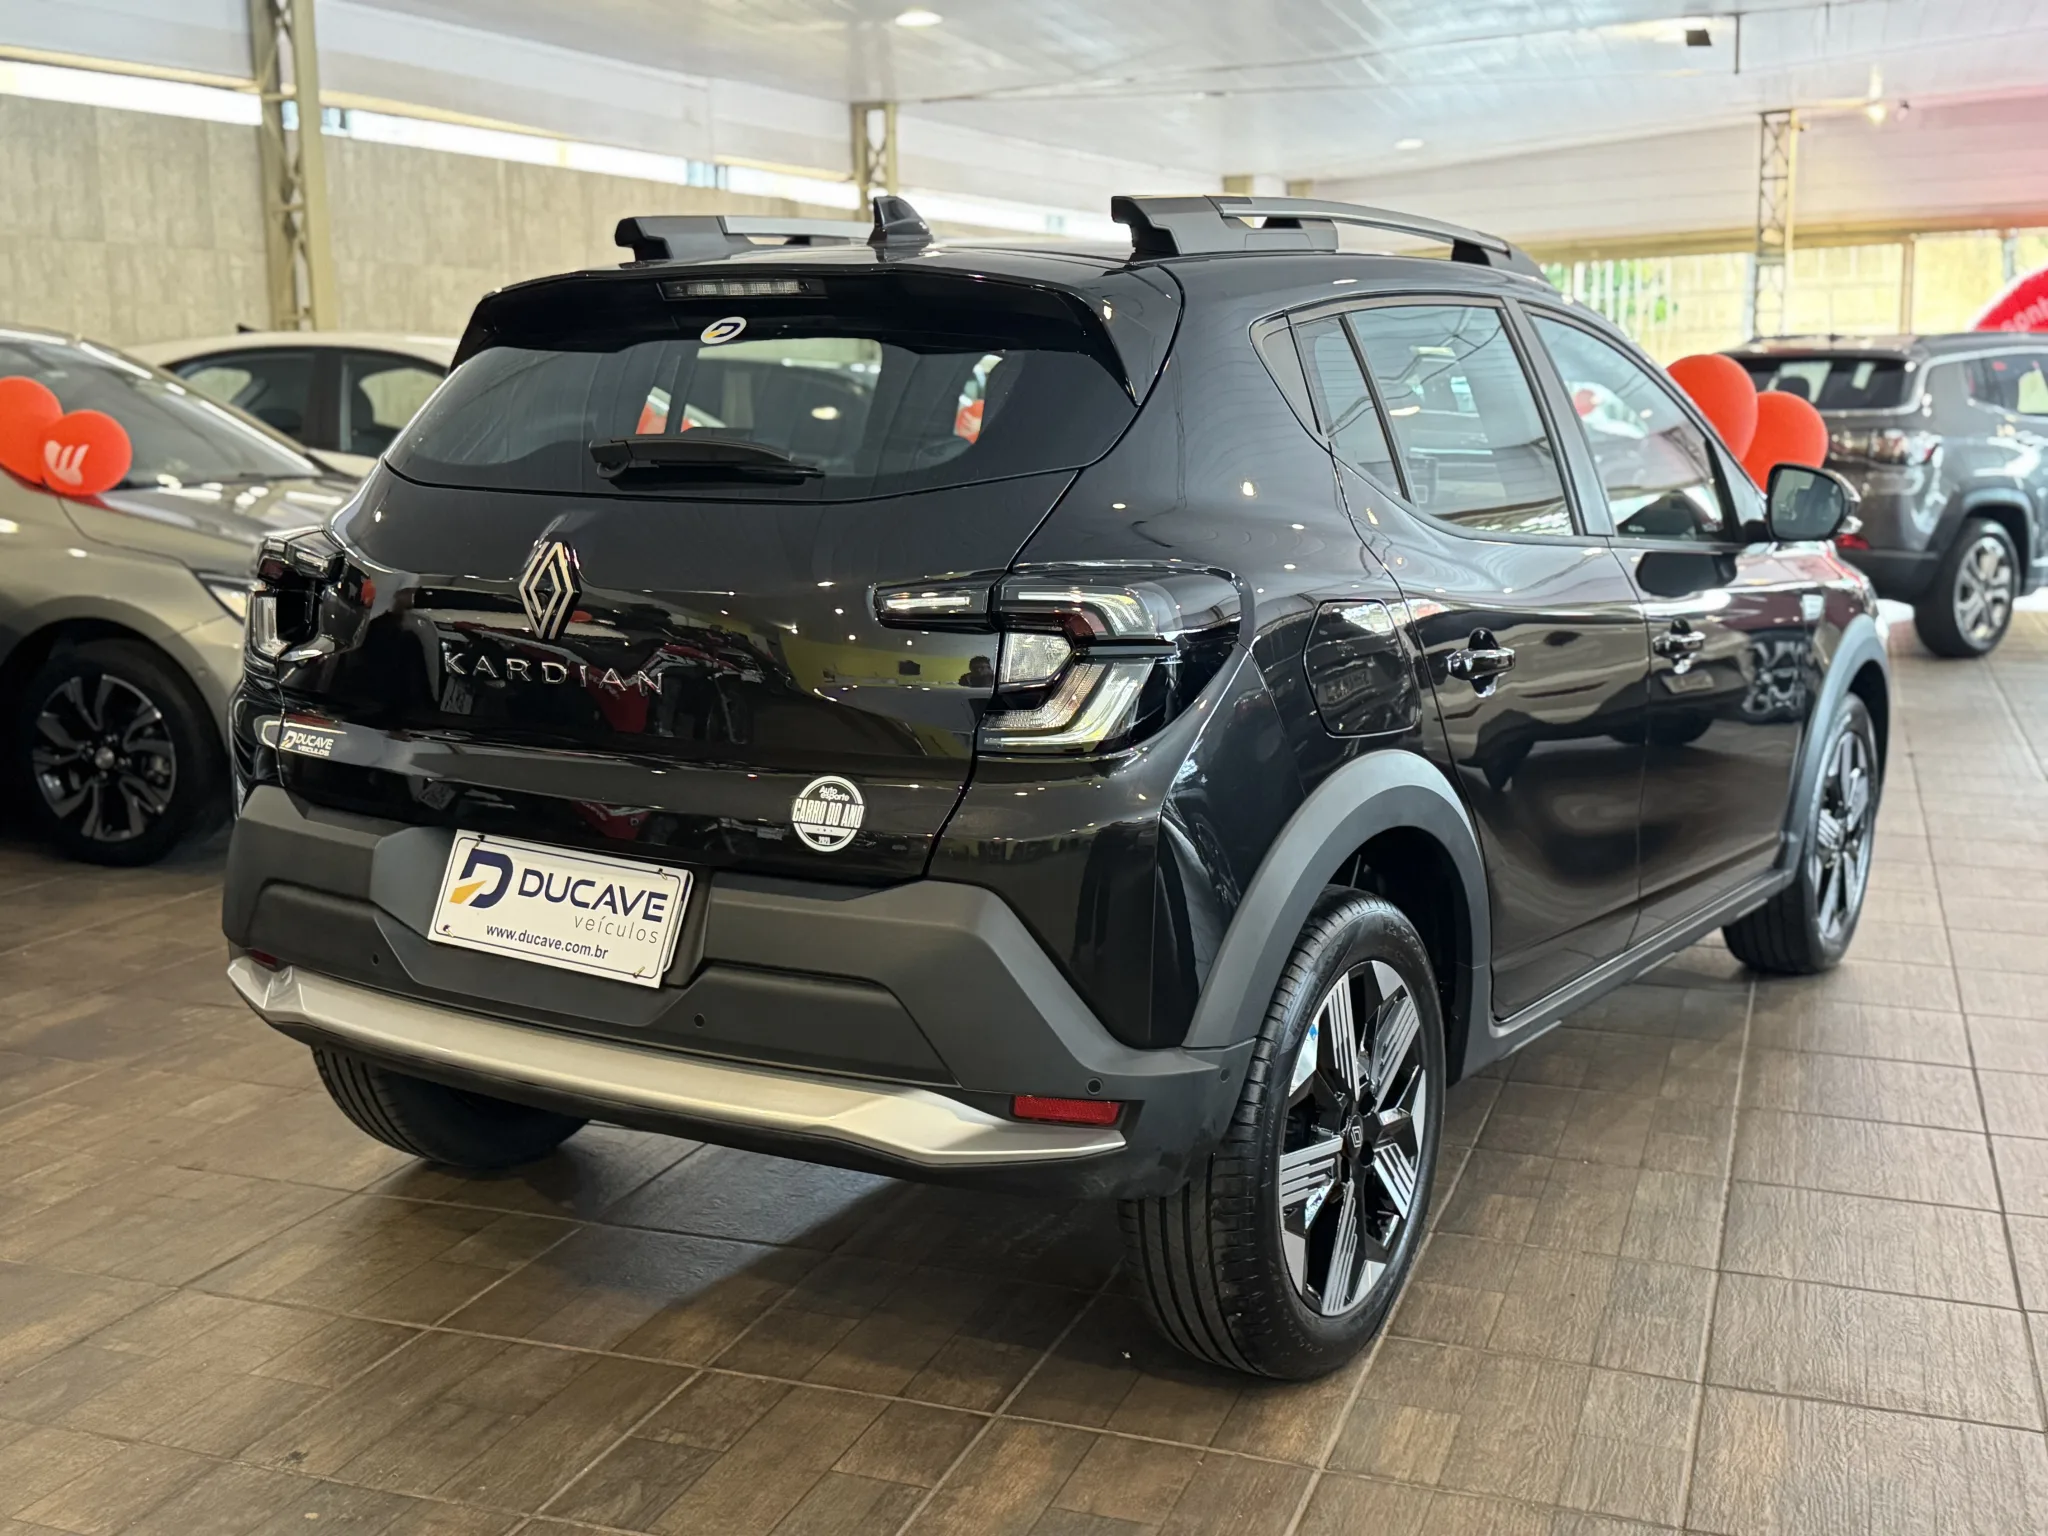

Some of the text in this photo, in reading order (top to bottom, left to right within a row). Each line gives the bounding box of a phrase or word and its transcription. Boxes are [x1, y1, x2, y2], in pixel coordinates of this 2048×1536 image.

[443, 651, 664, 697] KARDIAN
[296, 733, 333, 749] DUCAVE
[792, 799, 864, 828] CARRO DO ANO
[517, 868, 669, 922] DUCAVE
[485, 924, 609, 960] www.ducave.com.br
[573, 913, 659, 944] veículos
